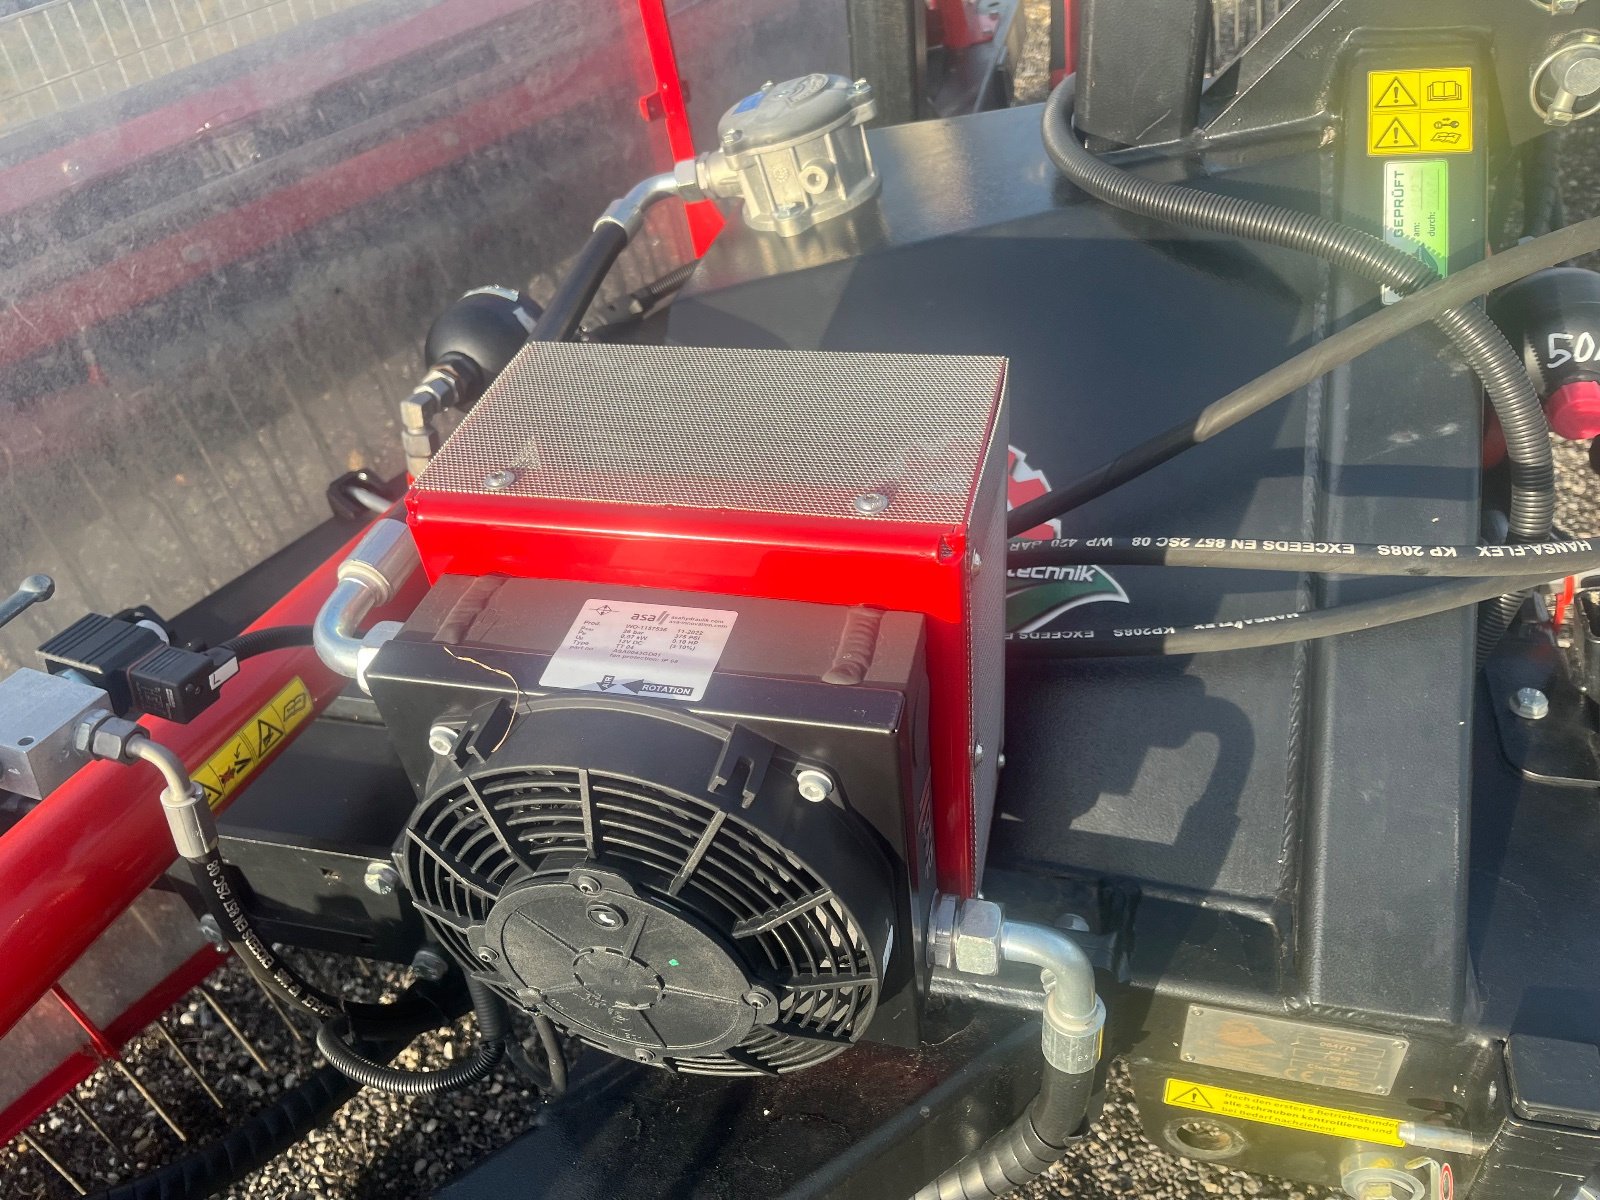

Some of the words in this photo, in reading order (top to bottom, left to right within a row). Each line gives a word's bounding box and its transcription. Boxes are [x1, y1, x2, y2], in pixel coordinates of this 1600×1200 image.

[1391, 170, 1405, 238] GEPRÜFT
[1413, 222, 1421, 237] am:
[1427, 211, 1436, 237] durch:
[1131, 537, 1152, 547] 08
[1156, 537, 1191, 548] 2SC
[1195, 538, 1226, 549] 857
[1230, 539, 1257, 549] EN
[1262, 540, 1355, 554] EXCEEDS
[1476, 539, 1592, 557] HANSA-FLEX
[1377, 544, 1424, 557] 208S
[1430, 546, 1457, 557] KP
[629, 613, 657, 621] asa
[641, 684, 691, 694] ROTATION
[212, 875, 231, 900] 2SC
[223, 898, 240, 918] 857
[1224, 1092, 1249, 1101] Nach
[1251, 1097, 1271, 1105] den
[1273, 1102, 1305, 1112] ersten
[1223, 1099, 1241, 1107] alle
[1243, 1103, 1298, 1118] Schrauben
[1301, 1114, 1369, 1130] kontrollieren
[1372, 1126, 1392, 1134] und
[1239, 1109, 1272, 1120] Bedarf
[1274, 1116, 1334, 1131] nachziehen!
